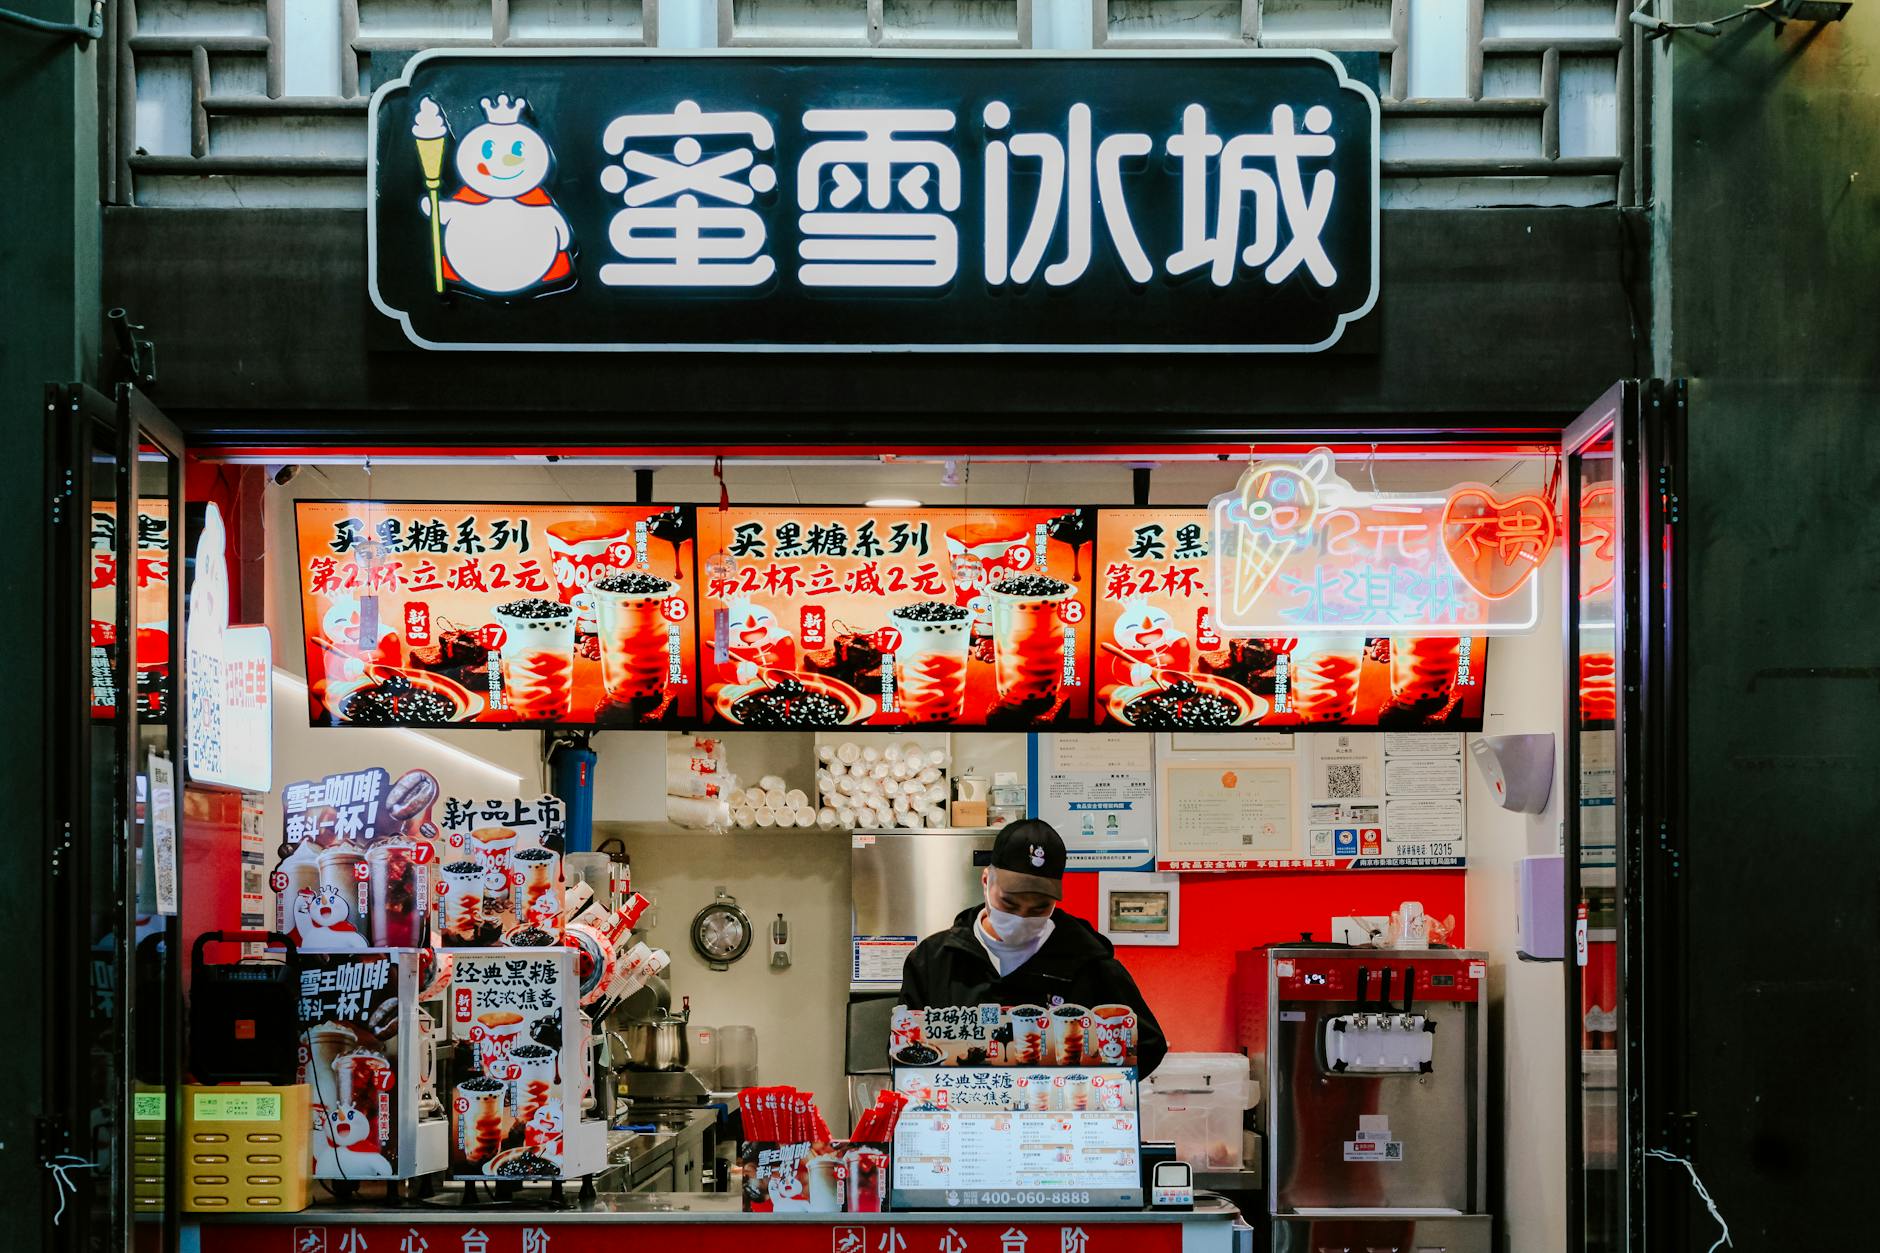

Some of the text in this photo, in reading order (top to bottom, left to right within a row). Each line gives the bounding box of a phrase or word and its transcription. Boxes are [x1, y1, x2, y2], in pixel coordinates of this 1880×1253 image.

[600, 99, 1337, 288] 蜜雪冰城
[329, 516, 529, 555] 买黑糖系列
[727, 521, 929, 558] 买黑糖系列
[1320, 506, 1430, 559] 2元
[1448, 511, 1545, 566] 不贵
[309, 558, 549, 596] 第2杯立减2元
[706, 562, 947, 598] 第2杯立减2元
[1279, 565, 1465, 624] 冰淇淋
[407, 608, 427, 640] 新品
[803, 611, 824, 643] 新品
[668, 625, 682, 685] 黑糖珍珠奶茶
[1064, 627, 1075, 686] 黑糖珍珠奶茶
[1457, 637, 1472, 685] 糖珍珠奶茶
[287, 770, 382, 813] 雪王咖啡
[442, 797, 560, 831] 新品上市
[1430, 843, 1452, 855] 12315
[300, 959, 391, 996] 雪王咖啡
[454, 959, 559, 987] 经典黑糖
[457, 993, 472, 1018] 新品
[476, 989, 556, 1011] 浓浓焦香
[924, 1009, 977, 1025] 扫码领
[925, 1025, 985, 1040] 30元券包
[934, 1073, 1014, 1090] 经典黑糖
[951, 1091, 1012, 1106] 浓浓焦香
[758, 1141, 811, 1164] 雪王咖啡
[981, 1191, 1090, 1205] 400-060-8888
[339, 1227, 550, 1253] 小心台阶
[878, 1227, 1089, 1253] 小心台阶
